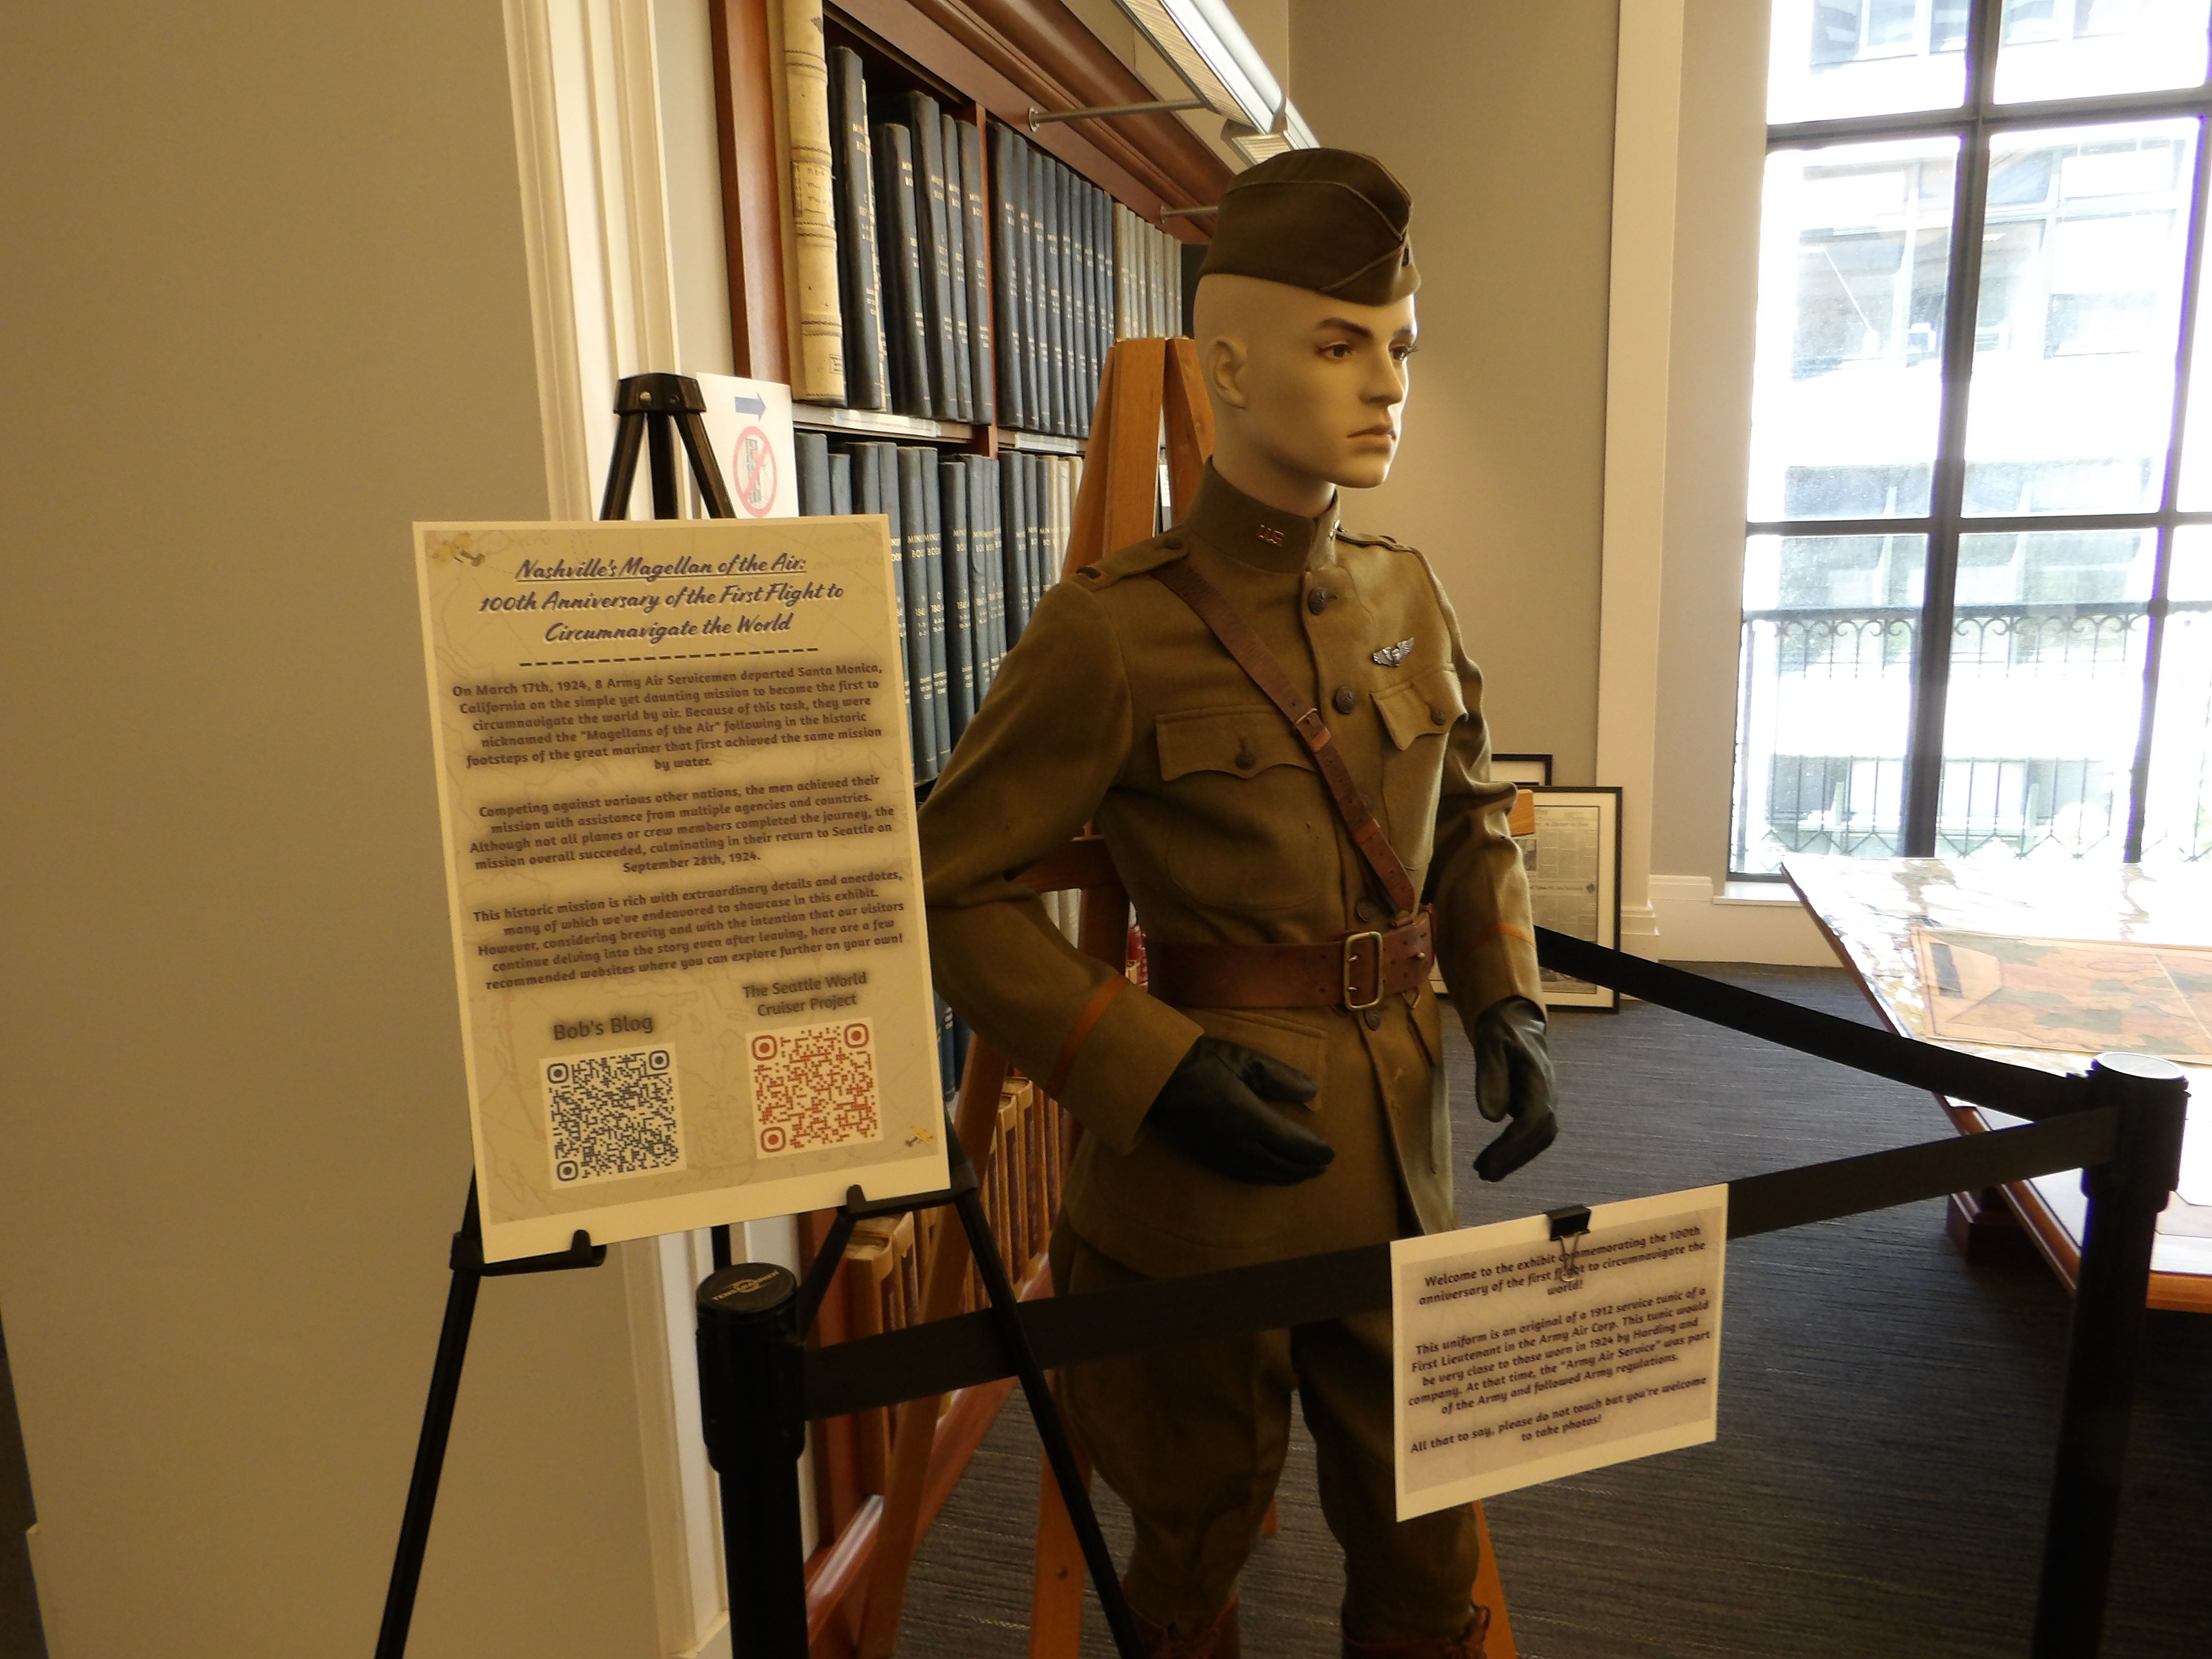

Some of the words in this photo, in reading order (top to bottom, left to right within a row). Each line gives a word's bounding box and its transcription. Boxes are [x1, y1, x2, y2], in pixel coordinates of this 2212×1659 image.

[514, 559, 617, 577] Nashville's
[617, 556, 712, 581] Magellan
[717, 554, 740, 575] of
[738, 554, 767, 572] the
[771, 552, 806, 571] Air:
[478, 592, 536, 610] 100th
[541, 590, 660, 614] Anniversary
[664, 586, 688, 608] of
[686, 586, 715, 604] the
[719, 585, 765, 602] First
[763, 582, 825, 606] Flight
[826, 583, 844, 598] to
[546, 620, 697, 646] Circumnavigate
[701, 616, 731, 634] the
[736, 613, 795, 631] World
[452, 685, 472, 697] On
[475, 682, 518, 696] March
[521, 681, 553, 694] 17th,
[556, 680, 591, 691] 1924,
[594, 679, 602, 689] 8
[606, 678, 641, 689] Army
[644, 675, 664, 686] Air
[667, 672, 737, 685] Servicemen
[739, 667, 795, 683] departed
[797, 667, 833, 677] Santa
[835, 662, 883, 675] Monica,
[459, 699, 526, 715] California
[529, 701, 546, 710] on
[549, 697, 570, 709] the
[573, 695, 617, 709] simple
[619, 694, 640, 707] yet
[643, 690, 701, 703] daunting
[703, 687, 749, 699] mission
[752, 687, 766, 696] to
[768, 685, 813, 695] become
[815, 682, 835, 692] the
[838, 680, 864, 693] first
[866, 680, 879, 689] to
[472, 715, 574, 731] circumnavigate
[577, 713, 599, 724] the
[602, 710, 639, 722] world
[642, 709, 659, 722] by
[661, 707, 682, 719] air.
[684, 705, 736, 717] Because
[737, 702, 751, 716] of
[752, 701, 776, 713] this
[779, 700, 809, 711] task,
[811, 698, 839, 710] they
[841, 697, 871, 707] were
[480, 732, 552, 748] nicknamed
[555, 731, 577, 742] the
[579, 727, 653, 742] "Magellans
[655, 724, 669, 738] of
[672, 723, 693, 734] the
[696, 721, 721, 733] Air"
[723, 717, 782, 734] following
[784, 716, 796, 727] in
[799, 715, 820, 725] the
[822, 711, 867, 724] historic
[466, 754, 528, 769] footsteps
[531, 749, 546, 763] of
[548, 749, 570, 760] the
[573, 747, 609, 761] great
[611, 742, 662, 756] mariner
[664, 740, 693, 752] that
[694, 738, 722, 752] first
[724, 733, 778, 747] achieved
[780, 733, 801, 743] the
[803, 731, 835, 742] same
[838, 726, 882, 739] mission
[653, 759, 670, 771] by
[673, 757, 713, 768] water.
[622, 857, 690, 874] September
[692, 853, 726, 866] 28th,
[728, 851, 761, 862] 1924.
[742, 985, 768, 998] The
[771, 978, 821, 995] Seattle
[824, 971, 867, 988] World
[757, 1001, 807, 1016] Cruiser
[809, 992, 858, 1010] Project
[553, 1020, 604, 1041] Bob's
[610, 1015, 654, 1034] Blog
[1424, 1270, 1478, 1287] Welcome
[1479, 1267, 1493, 1277] to
[1494, 1262, 1515, 1274] the
[1516, 1253, 1556, 1270] exhibit
[1648, 1233, 1668, 1244] the
[1668, 1225, 1700, 1240] 100th
[1419, 1285, 1488, 1307] anniversary
[1492, 1279, 1504, 1292] of
[1505, 1277, 1525, 1288] the
[1526, 1271, 1552, 1286] first
[1587, 1263, 1600, 1271] to
[1602, 1246, 1686, 1269] circumnavigate
[1687, 1241, 1706, 1252] the
[1546, 1279, 1583, 1295] world!
[1411, 1359, 1438, 1373] First
[1440, 1345, 1502, 1366] Lieutenant
[1504, 1341, 1516, 1352] in
[1517, 1338, 1537, 1349] the
[1538, 1331, 1569, 1345] Army
[1570, 1325, 1589, 1337] Air
[1621, 1315, 1644, 1326] This
[1646, 1307, 1674, 1321] tunic
[1675, 1299, 1710, 1315] would
[1415, 1341, 1440, 1355] This
[1442, 1333, 1487, 1350] uniform
[1490, 1328, 1500, 1340] is
[1502, 1327, 1516, 1337] an
[1518, 1314, 1563, 1333] original
[1565, 1311, 1578, 1324] of
[1579, 1312, 1587, 1320] a
[1615, 1298, 1654, 1315] service
[1655, 1290, 1683, 1304] tunic
[1685, 1286, 1697, 1299] of
[1698, 1288, 1706, 1296] a
[1409, 1440, 1427, 1454] All
[1429, 1435, 1455, 1448] that
[1455, 1432, 1470, 1441] to
[1471, 1427, 1494, 1439] say,
[1497, 1417, 1534, 1435] please
[1534, 1412, 1550, 1423] do
[1551, 1407, 1571, 1419] not
[1572, 1398, 1602, 1414] touch
[1604, 1394, 1624, 1406] but
[1625, 1387, 1660, 1403] you're
[1661, 1377, 1707, 1393] welcome
[1520, 1432, 1534, 1441] to
[1534, 1425, 1560, 1438] take
[1561, 1413, 1601, 1434] photos!
